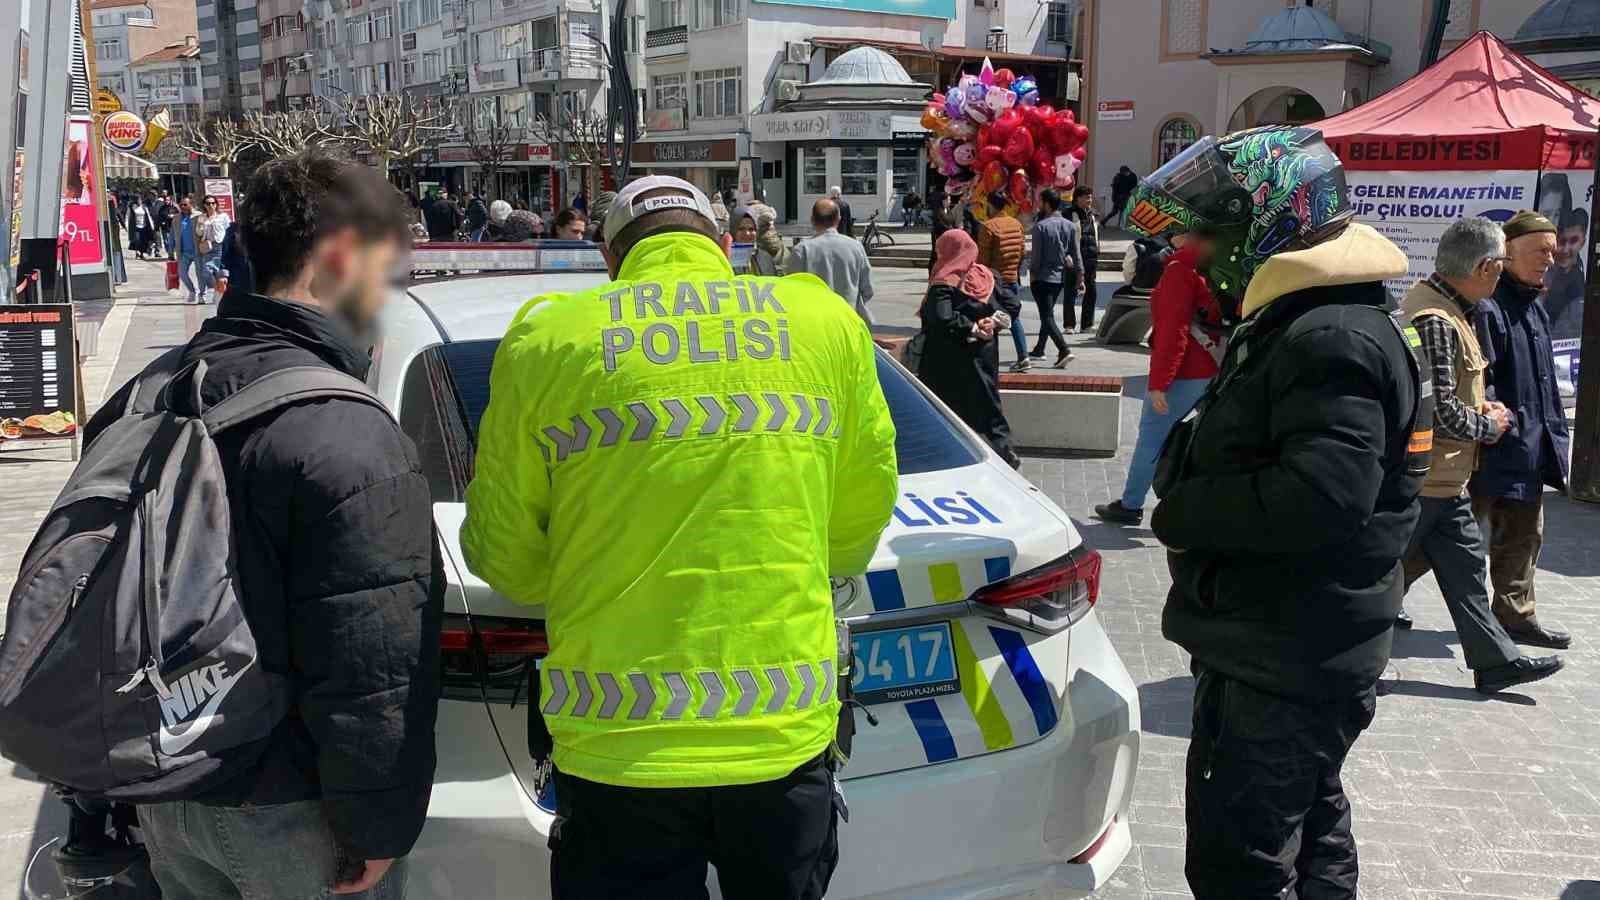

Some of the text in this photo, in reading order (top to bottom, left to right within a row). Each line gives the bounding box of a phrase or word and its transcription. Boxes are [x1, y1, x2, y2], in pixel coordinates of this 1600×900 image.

[109, 121, 141, 129] BURGER
[109, 129, 142, 138] KING
[1351, 136, 1503, 161] BELEDİYESİ
[1355, 184, 1405, 198] GELEN
[1408, 183, 1524, 200] EMANETİNE
[1378, 203, 1407, 220] ÇIK
[1410, 204, 1464, 218] BOLU!
[158, 661, 234, 729] NIKE
[887, 690, 914, 698] TOYOTA
[914, 687, 935, 695] PLAZA
